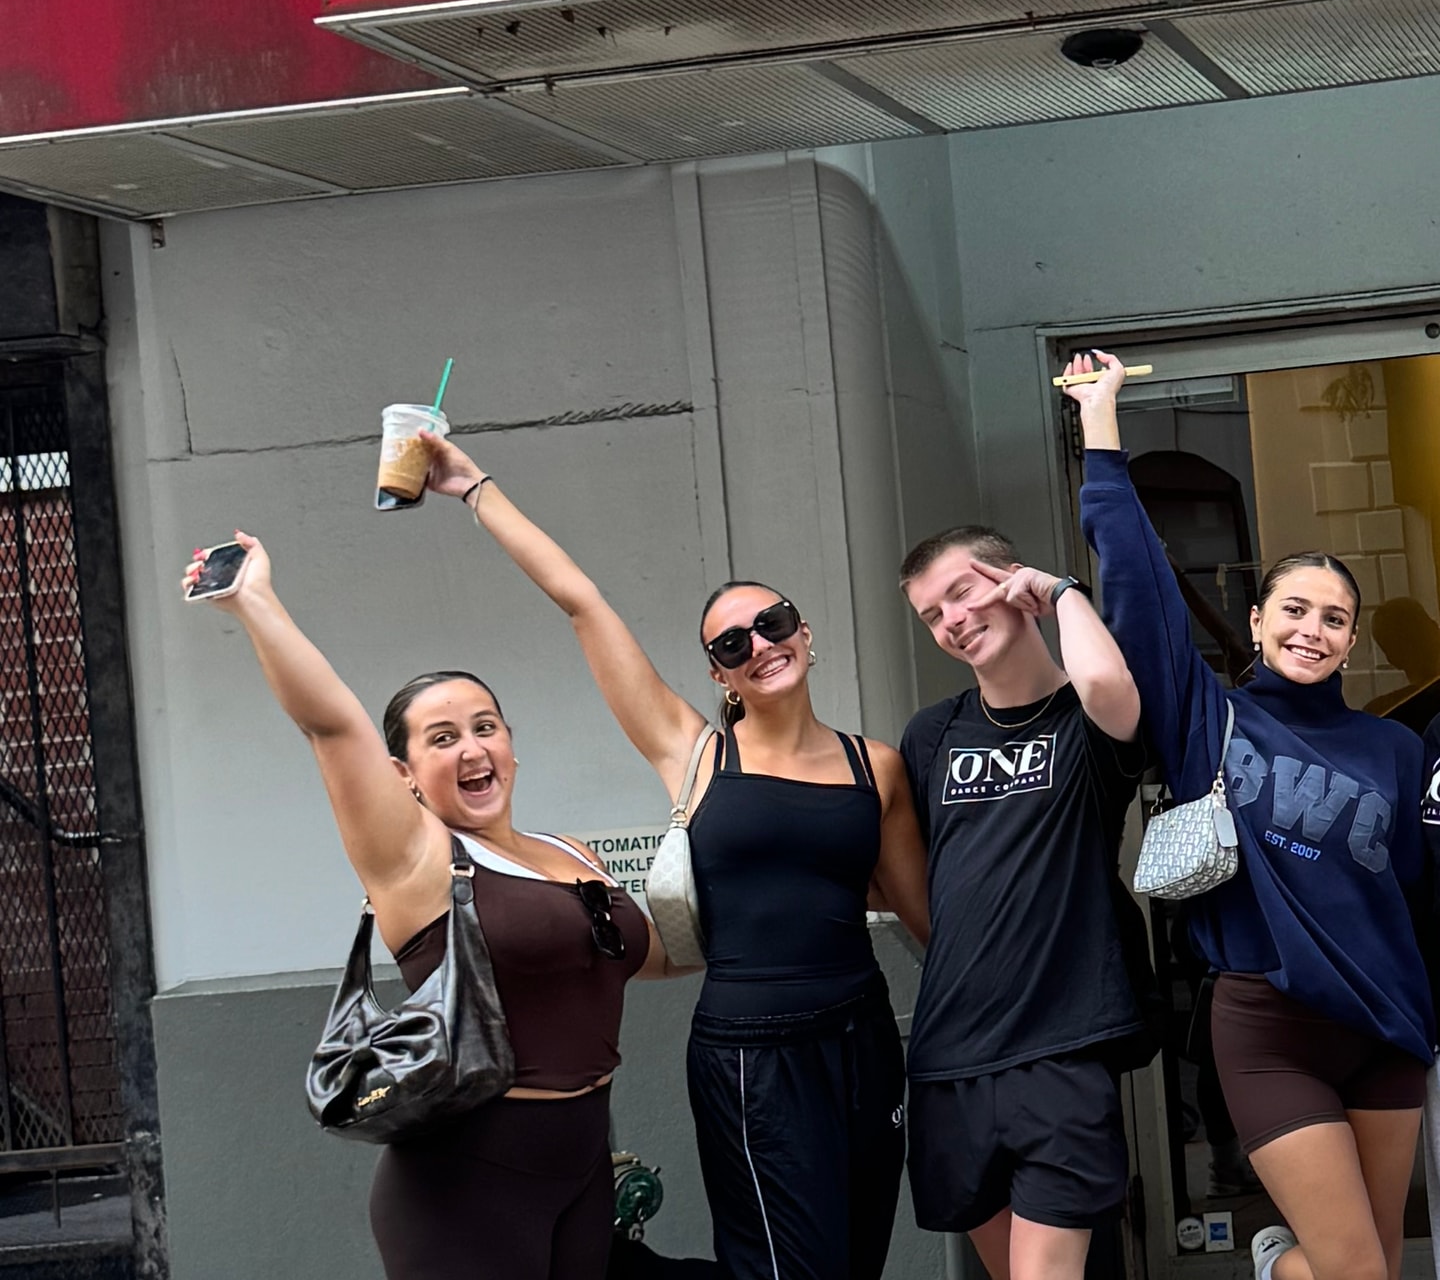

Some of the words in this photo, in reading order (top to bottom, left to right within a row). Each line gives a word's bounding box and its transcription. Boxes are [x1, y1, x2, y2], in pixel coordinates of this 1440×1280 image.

[952, 741, 1048, 784] ONE
[951, 786, 986, 795] DANCE
[1225, 739, 1391, 873] BWC
[1264, 830, 1287, 849] EST.
[1290, 841, 1321, 861] 2007
